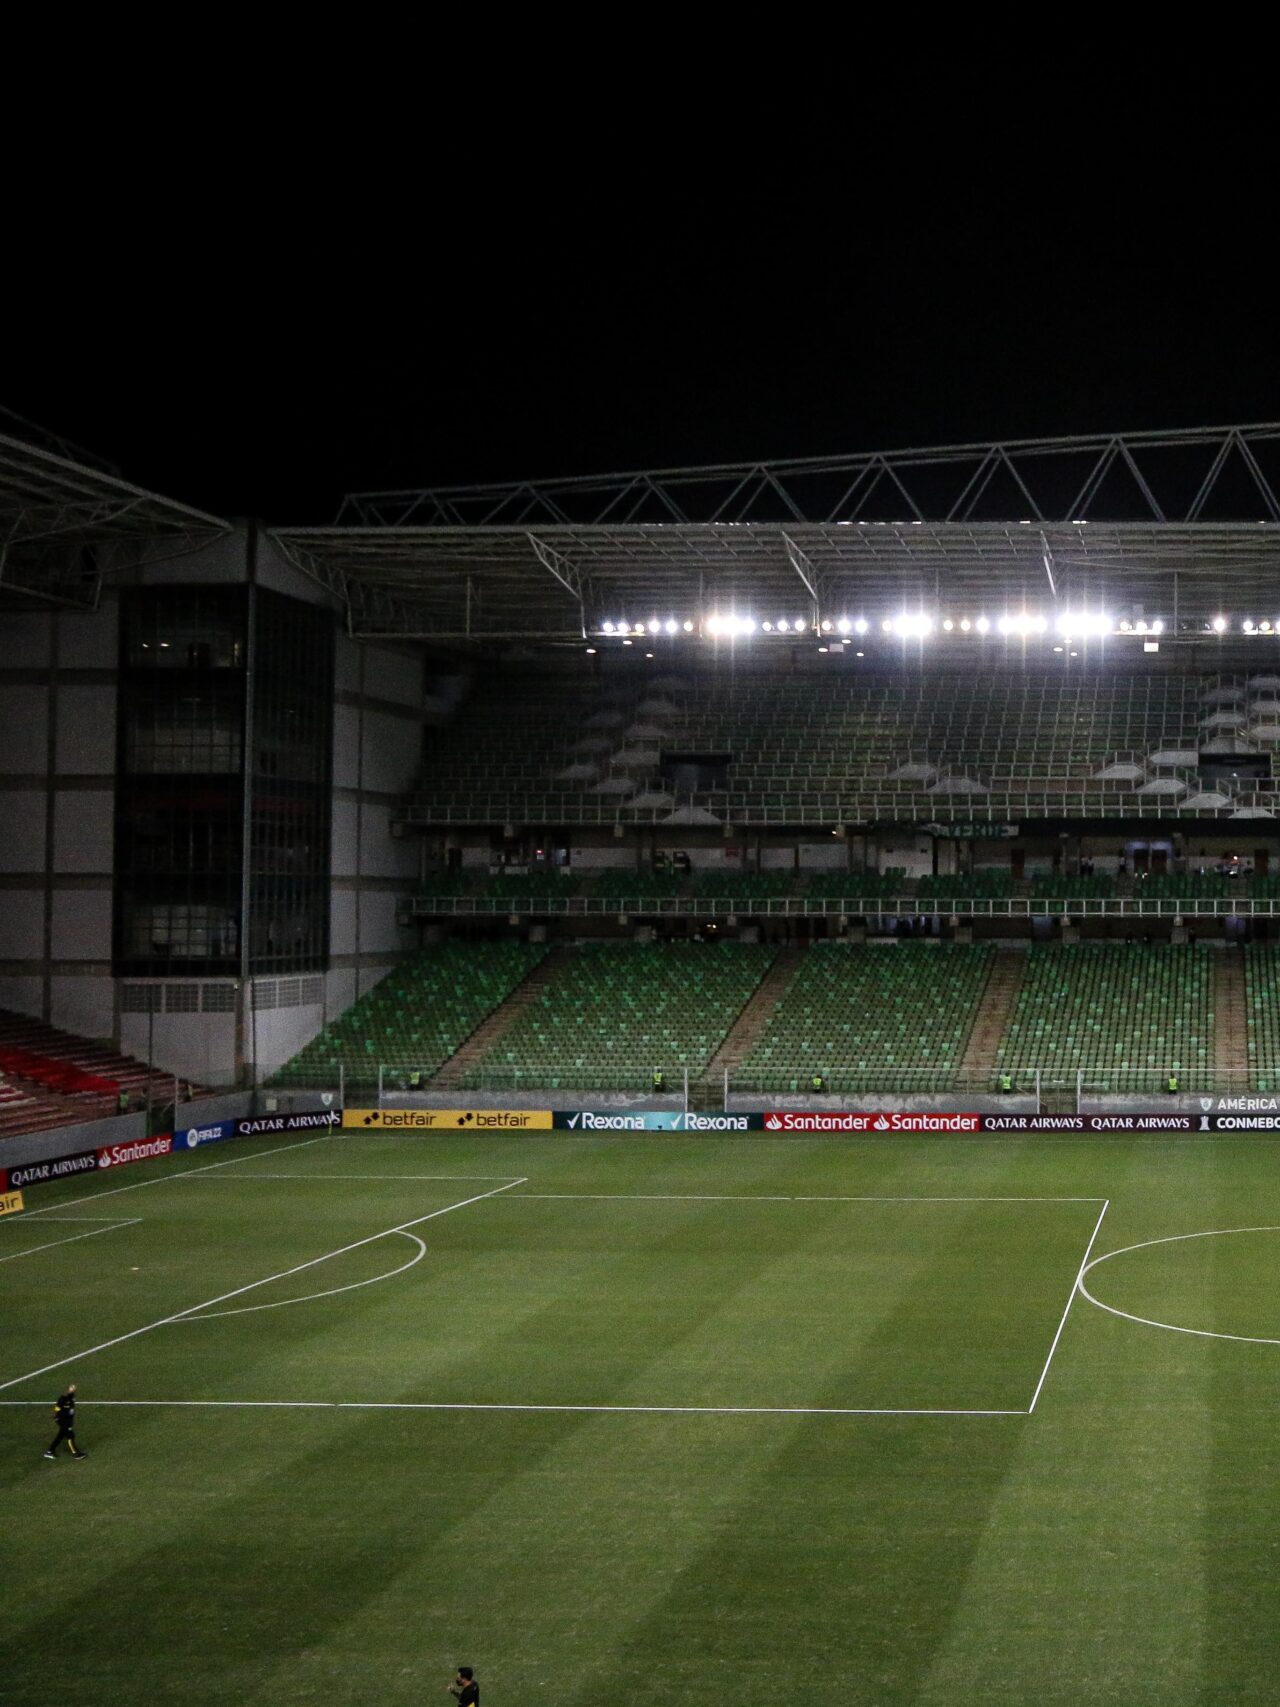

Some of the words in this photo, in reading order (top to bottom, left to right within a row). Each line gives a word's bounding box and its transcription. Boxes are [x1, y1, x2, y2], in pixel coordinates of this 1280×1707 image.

[1217, 1096, 1278, 1111] AMÉRICA
[238, 1117, 285, 1134] QATAR
[288, 1112, 341, 1128] AIRWAYS
[382, 1111, 438, 1126] betfair
[476, 1112, 531, 1127] betfair
[581, 1113, 645, 1130] Rexona
[684, 1113, 748, 1130] Rexona
[783, 1114, 870, 1130] Santander
[891, 1114, 979, 1130] Santander
[985, 1117, 1028, 1130] QATAR
[1029, 1117, 1084, 1129] AIRWAYS
[1091, 1117, 1134, 1130] QATAR
[1136, 1117, 1190, 1129] AIRWAYS
[111, 1137, 172, 1165] Santander
[11, 1165, 50, 1186] QATAR
[51, 1154, 95, 1176] AIRWAYS
